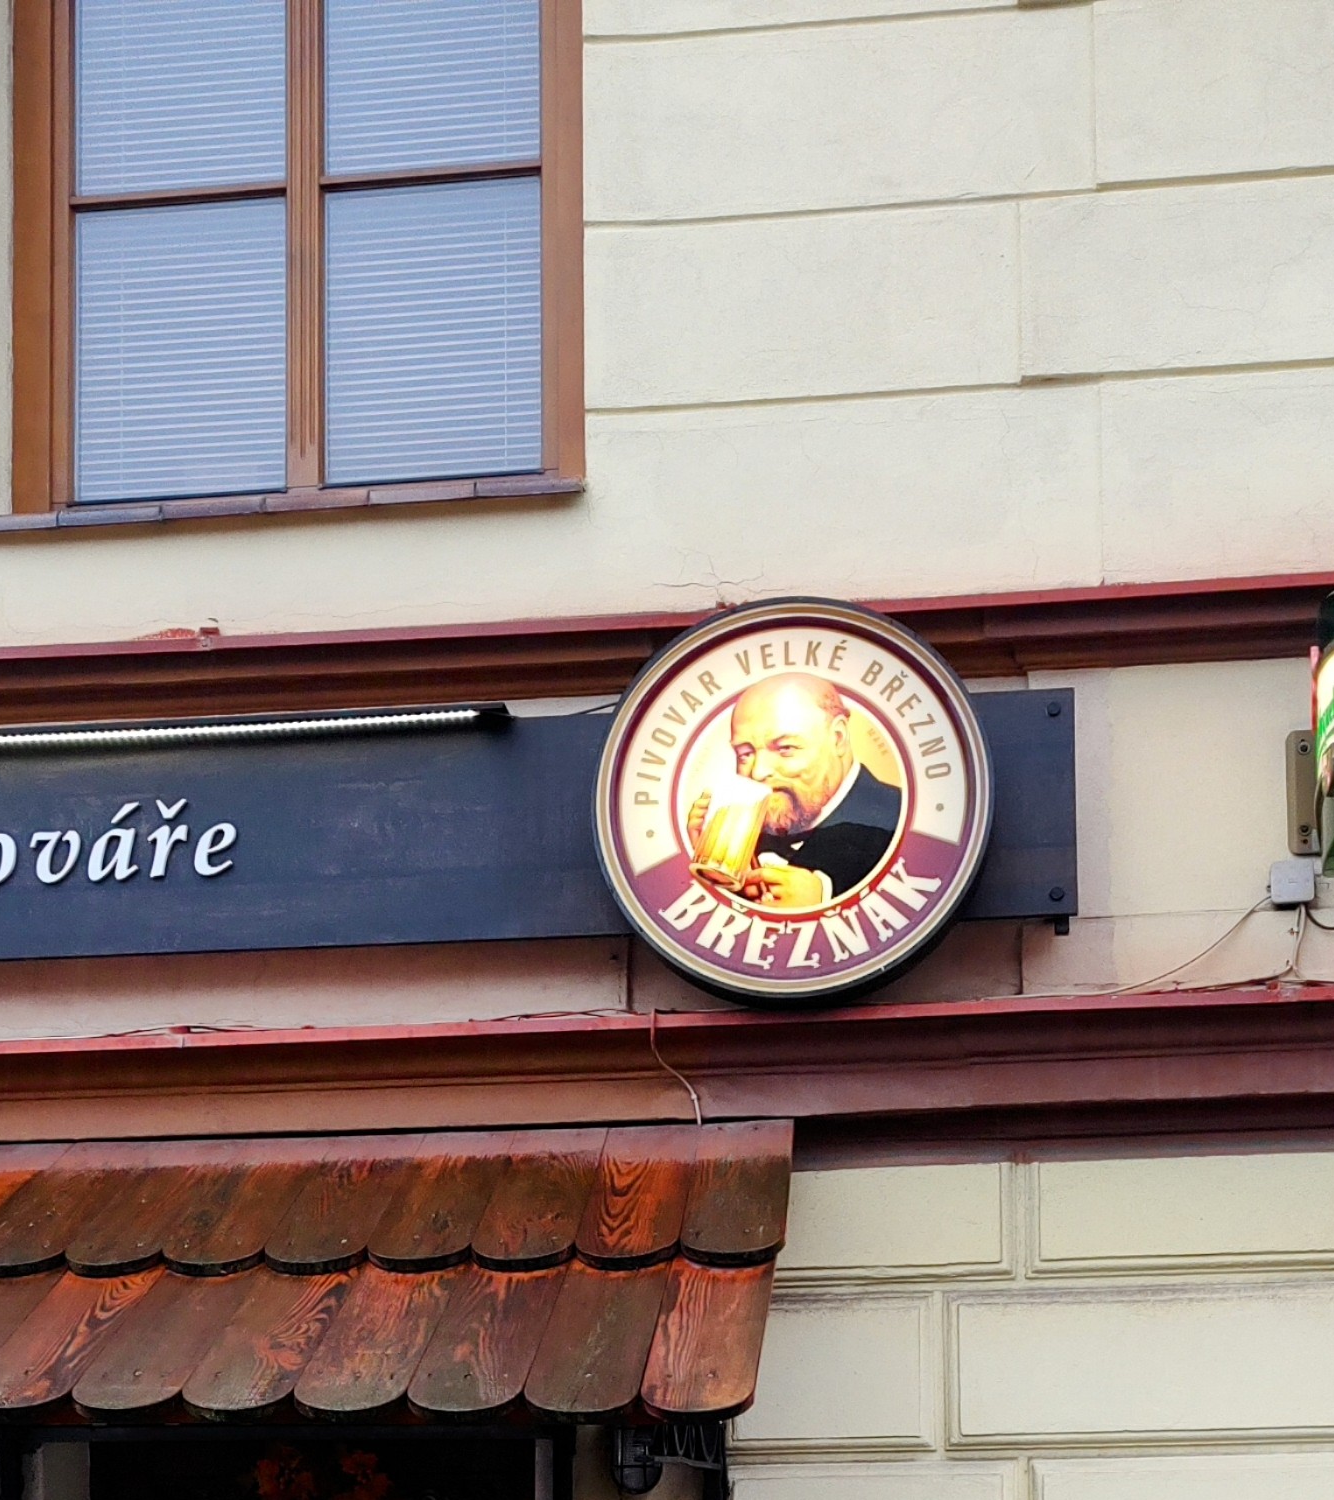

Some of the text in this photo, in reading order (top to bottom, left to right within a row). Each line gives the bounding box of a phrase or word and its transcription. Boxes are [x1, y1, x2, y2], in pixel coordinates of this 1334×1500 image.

[634, 639, 952, 807] PIVOVAR VELKÉ BŘEZNO
[658, 857, 942, 970] BŘEZŇÁK
